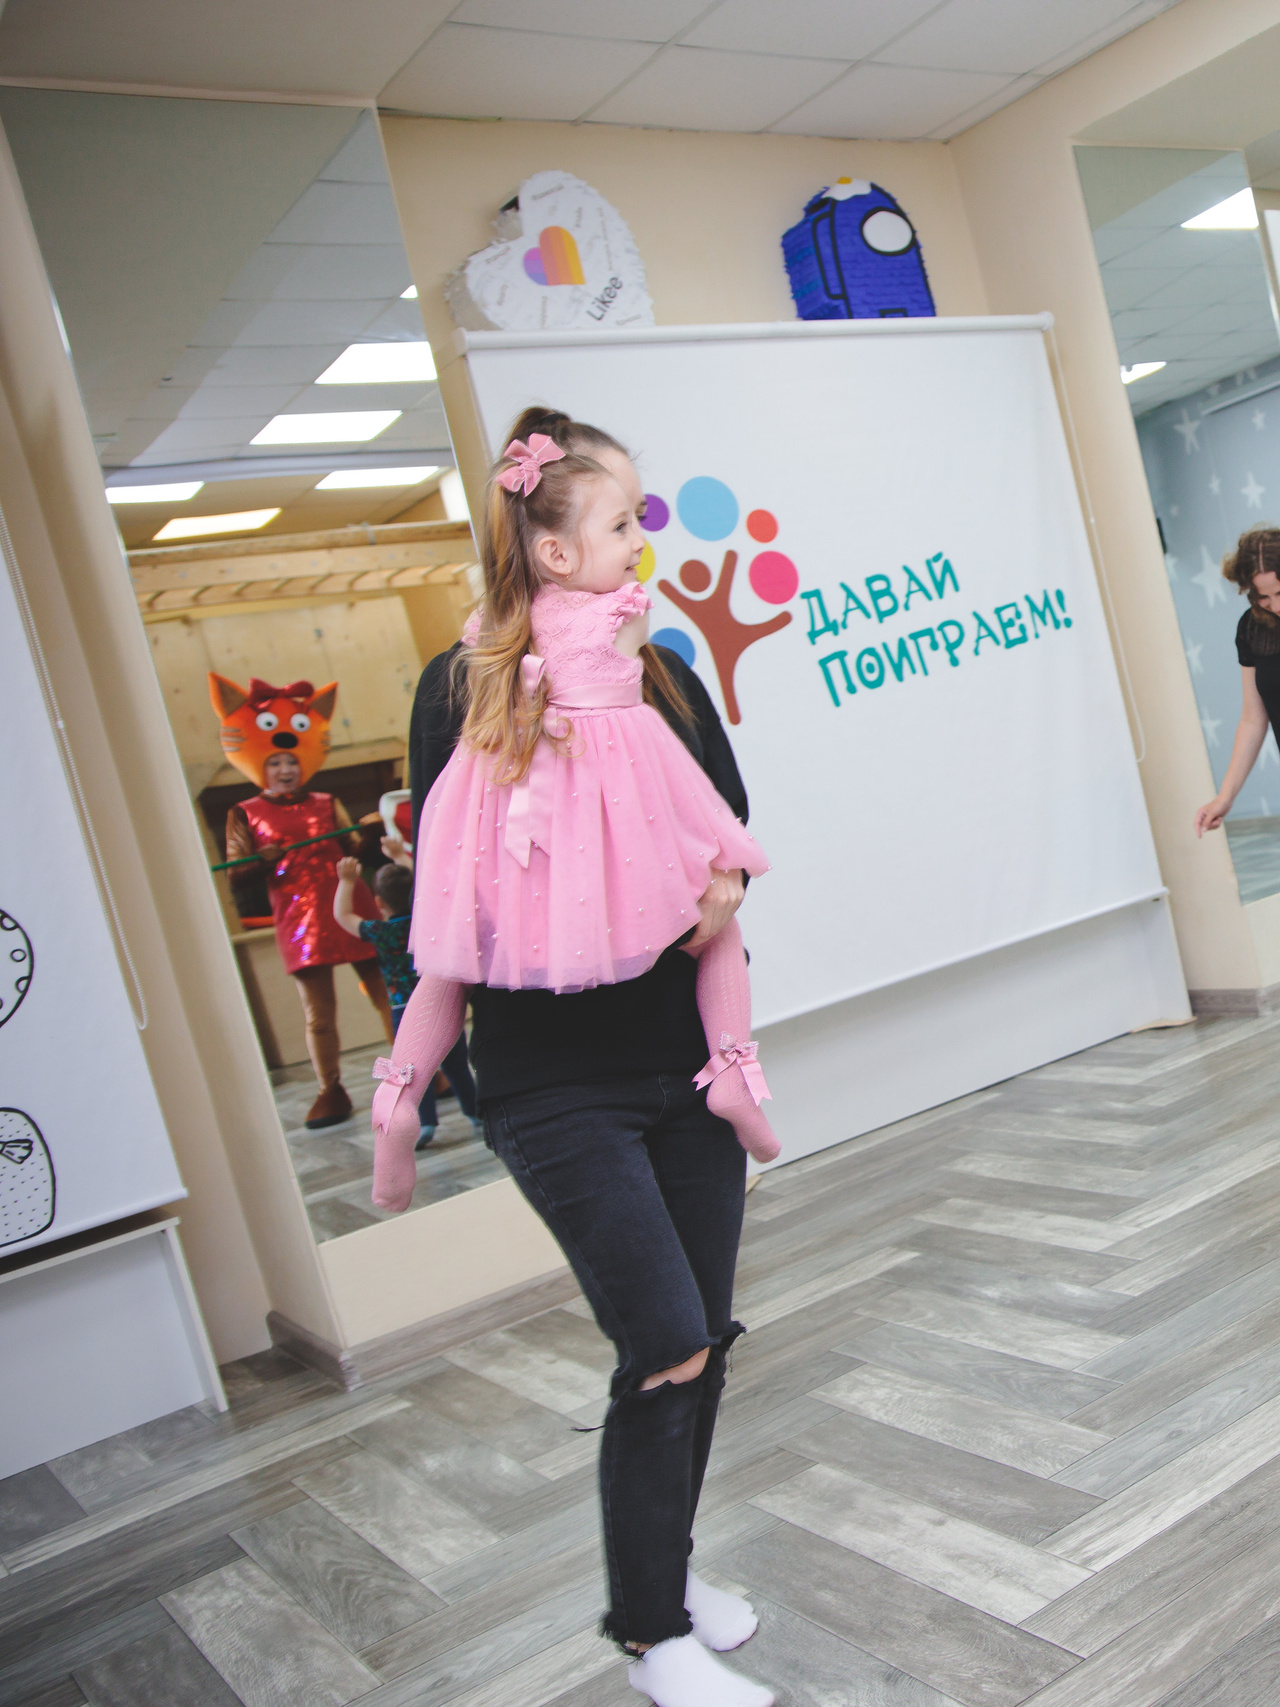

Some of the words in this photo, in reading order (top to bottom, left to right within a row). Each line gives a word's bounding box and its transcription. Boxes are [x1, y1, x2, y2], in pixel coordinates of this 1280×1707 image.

[586, 277, 623, 321] Likee
[800, 552, 960, 645] ДАВАЙ
[818, 589, 1073, 707] ПОИГРАЕМ!
